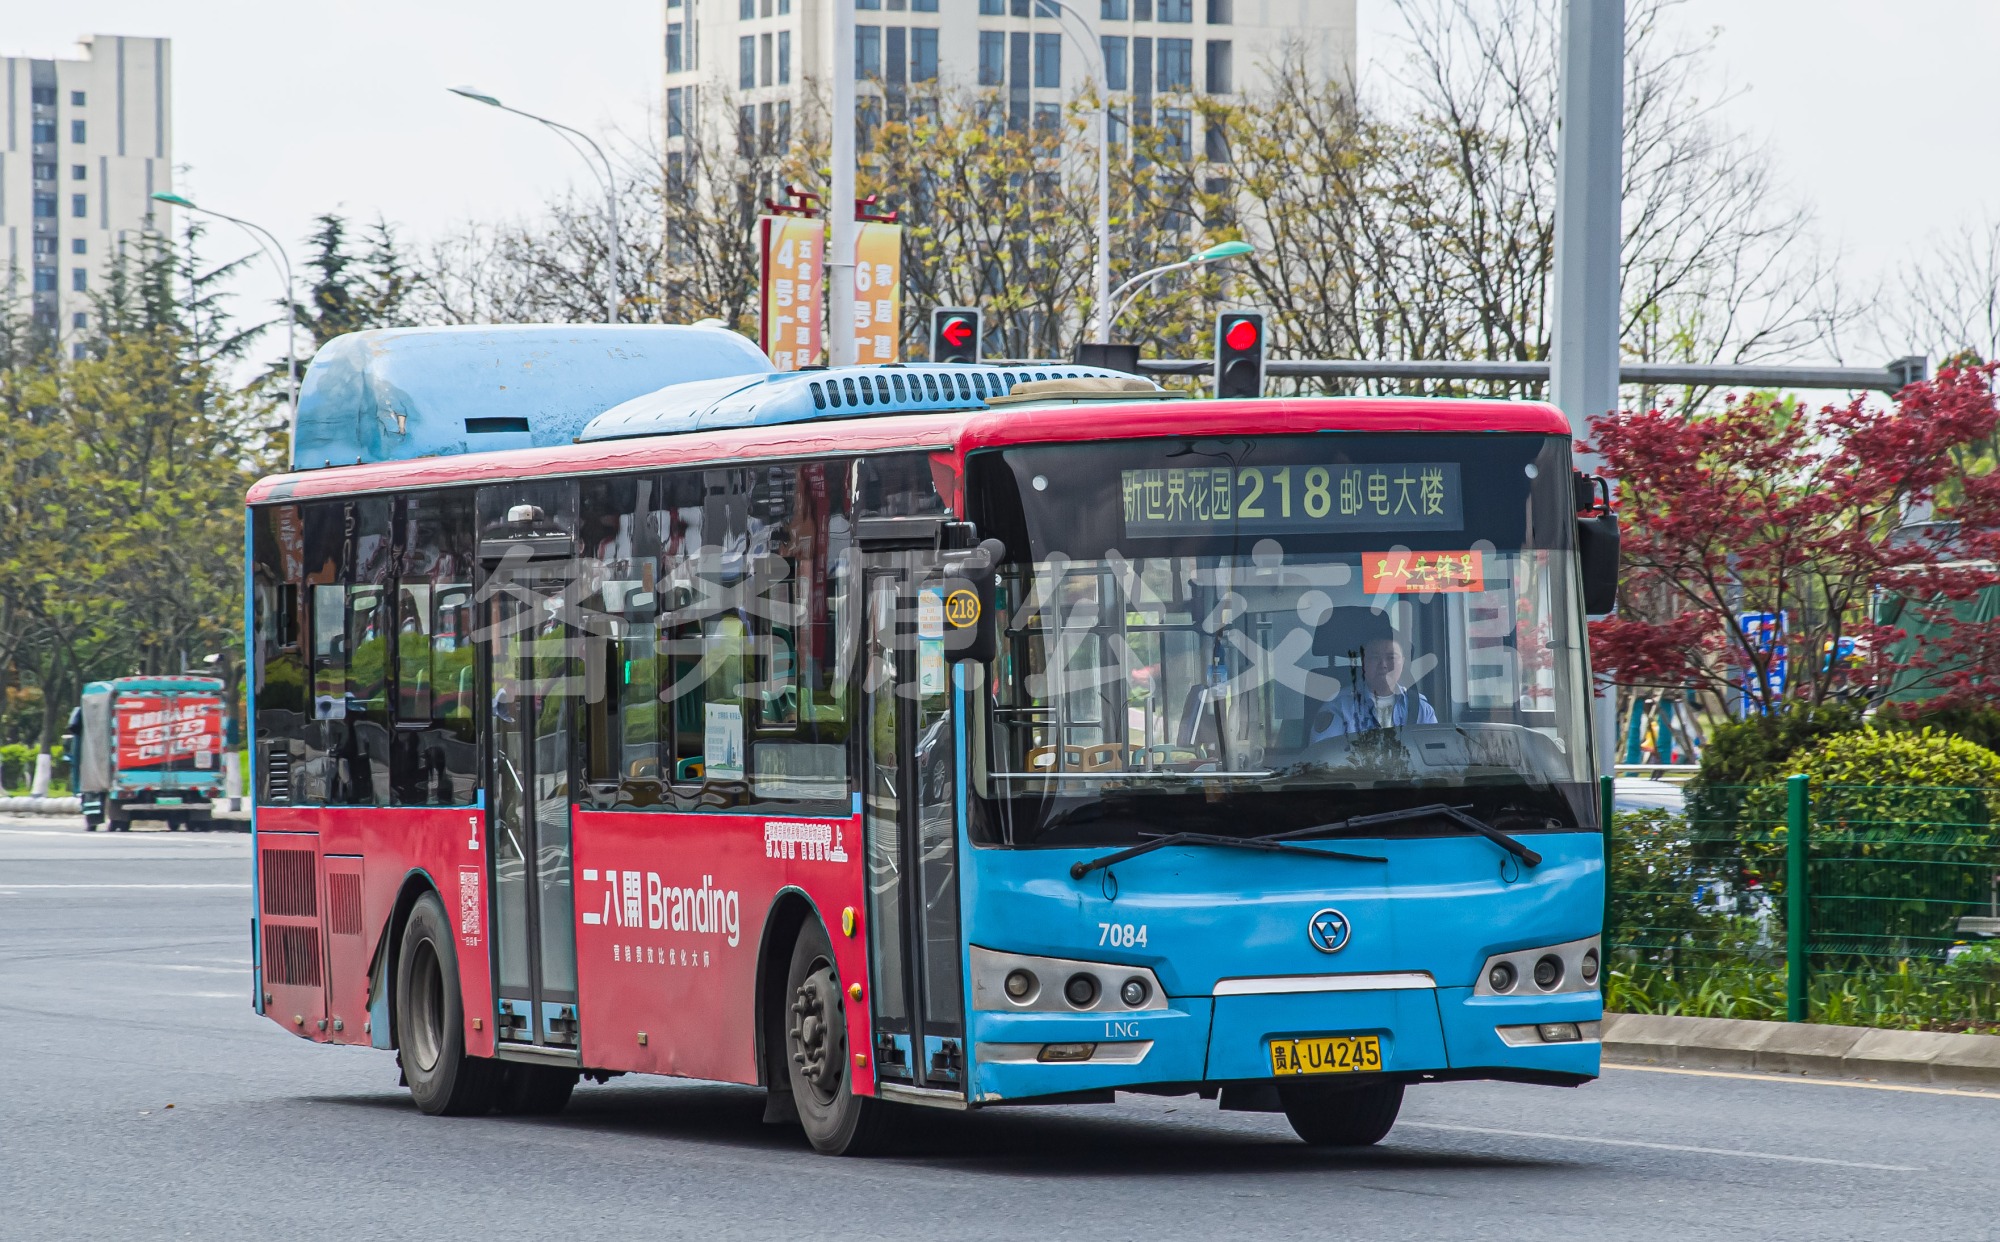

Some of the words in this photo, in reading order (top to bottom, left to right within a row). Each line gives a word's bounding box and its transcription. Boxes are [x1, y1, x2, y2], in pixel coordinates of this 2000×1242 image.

[1122, 468, 1231, 522] 新世界花园
[1237, 466, 1332, 519] 218
[1340, 466, 1445, 516] 邮电大楼
[1373, 554, 1473, 583] 工人先锋号
[951, 599, 975, 619] 218
[648, 872, 740, 947] Branding
[1099, 923, 1147, 947] 7084
[1105, 1022, 1139, 1038] LNG
